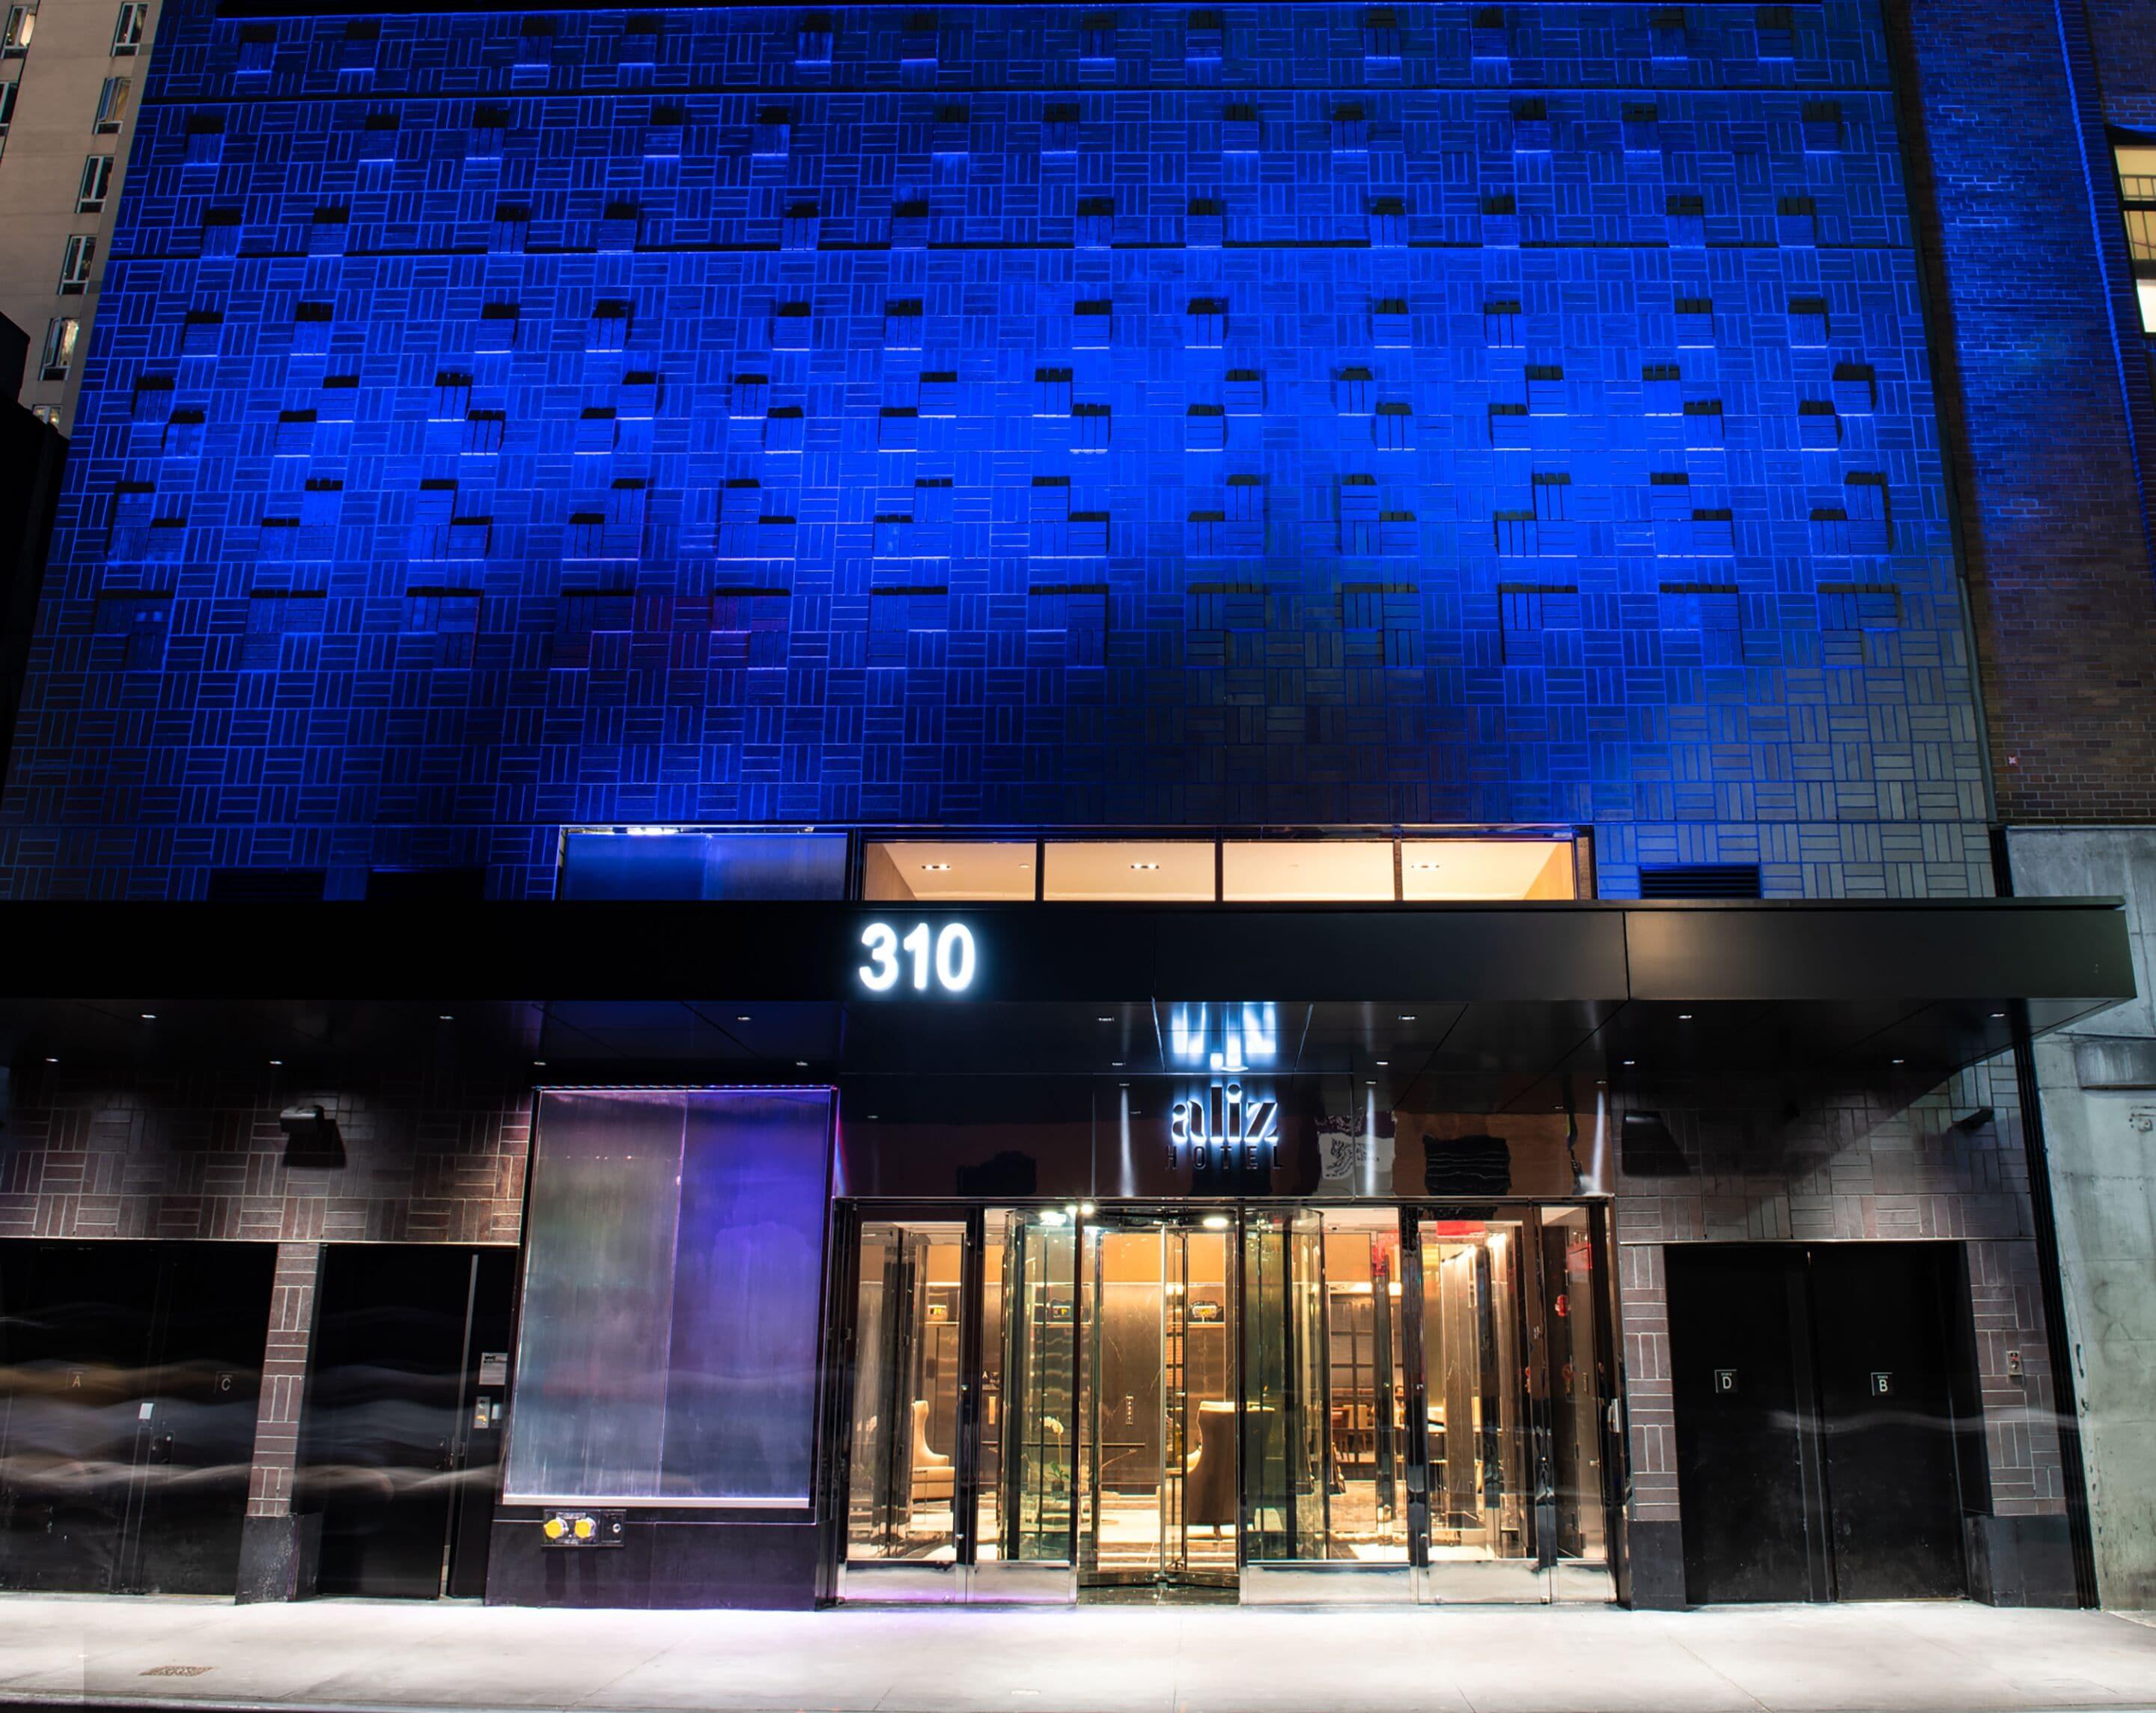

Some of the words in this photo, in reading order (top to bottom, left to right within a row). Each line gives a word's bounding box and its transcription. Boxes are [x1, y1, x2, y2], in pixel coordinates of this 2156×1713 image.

[859, 922, 976, 992] 310
[1172, 1083, 1279, 1142] aliz
[1168, 1145, 1282, 1170] HOTEL
[72, 1375, 81, 1388] A
[221, 1378, 231, 1391] C
[1723, 1376, 1732, 1389] D
[1879, 1379, 1888, 1392] B
